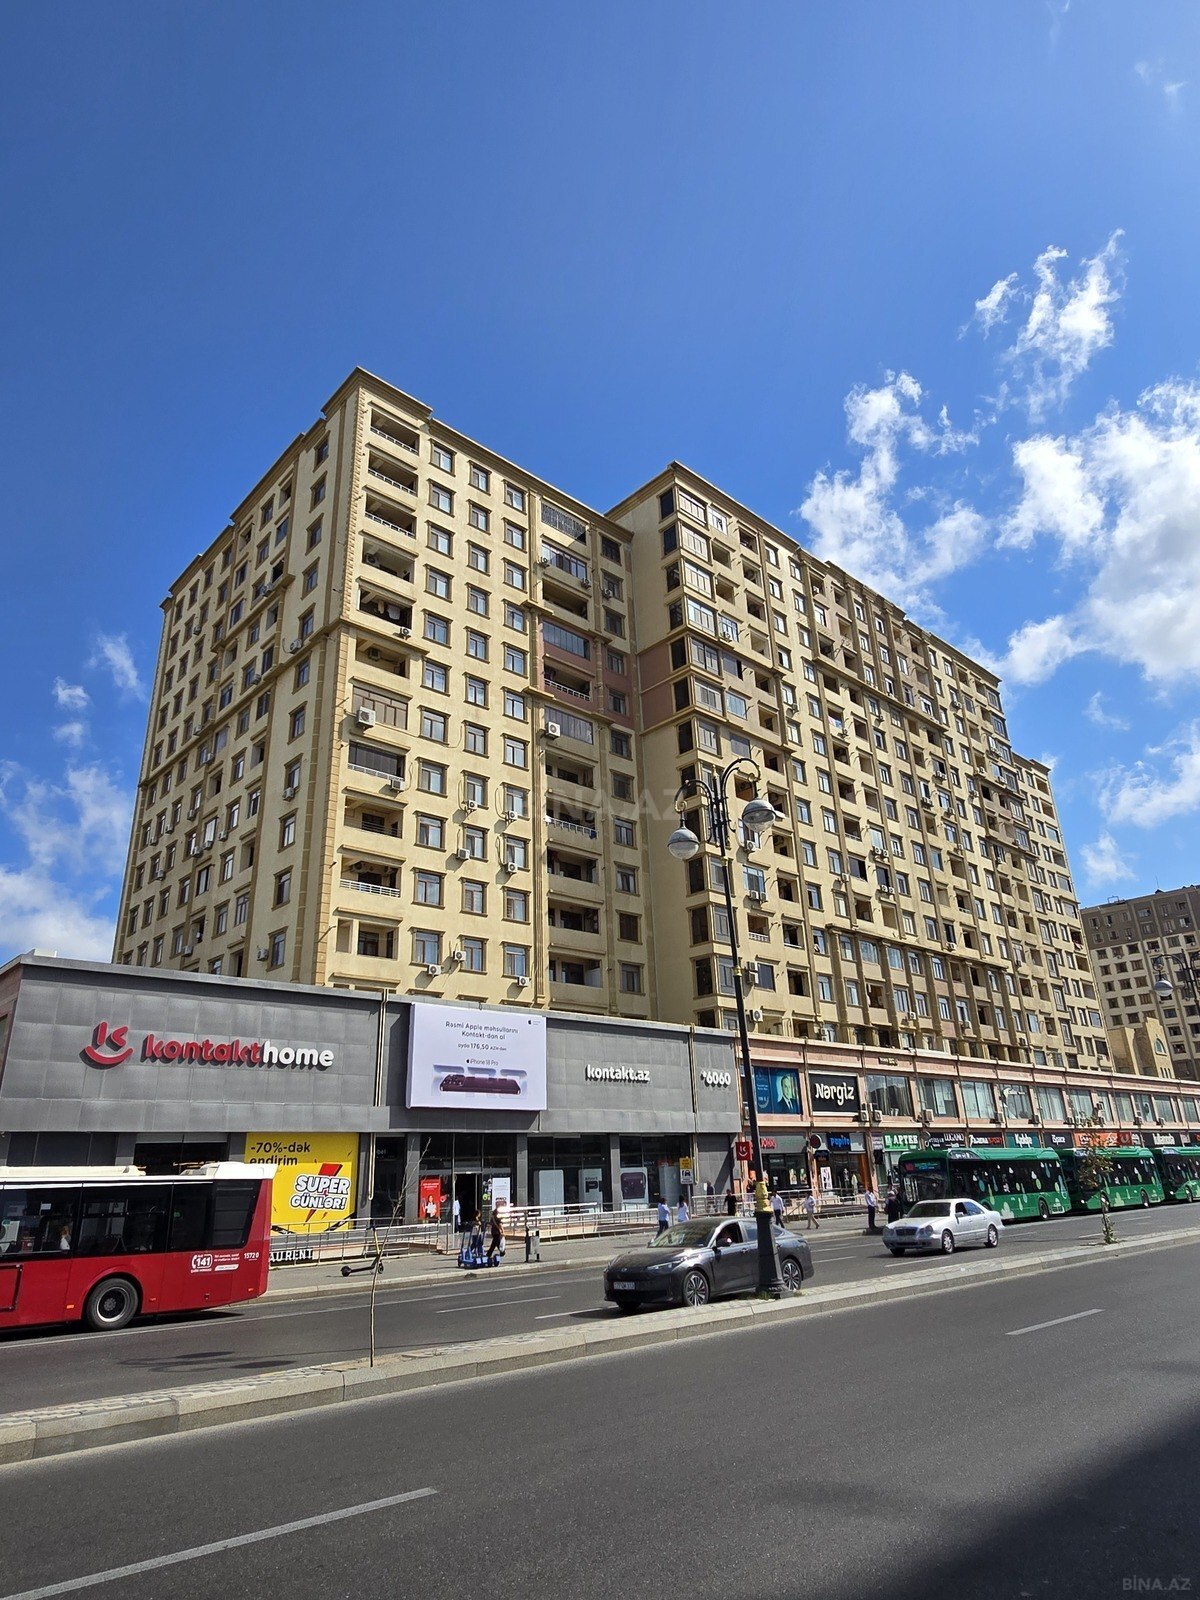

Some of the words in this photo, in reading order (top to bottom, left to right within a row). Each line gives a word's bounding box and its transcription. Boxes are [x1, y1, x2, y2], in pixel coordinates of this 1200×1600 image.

[465, 1023, 483, 1031] Apple
[587, 1063, 650, 1081] kontakt.az
[250, 1141, 311, 1154] -70%-dək
[249, 1155, 298, 1166] endirim
[294, 1174, 350, 1196] SUPER
[196, 1257, 211, 1267] 141
